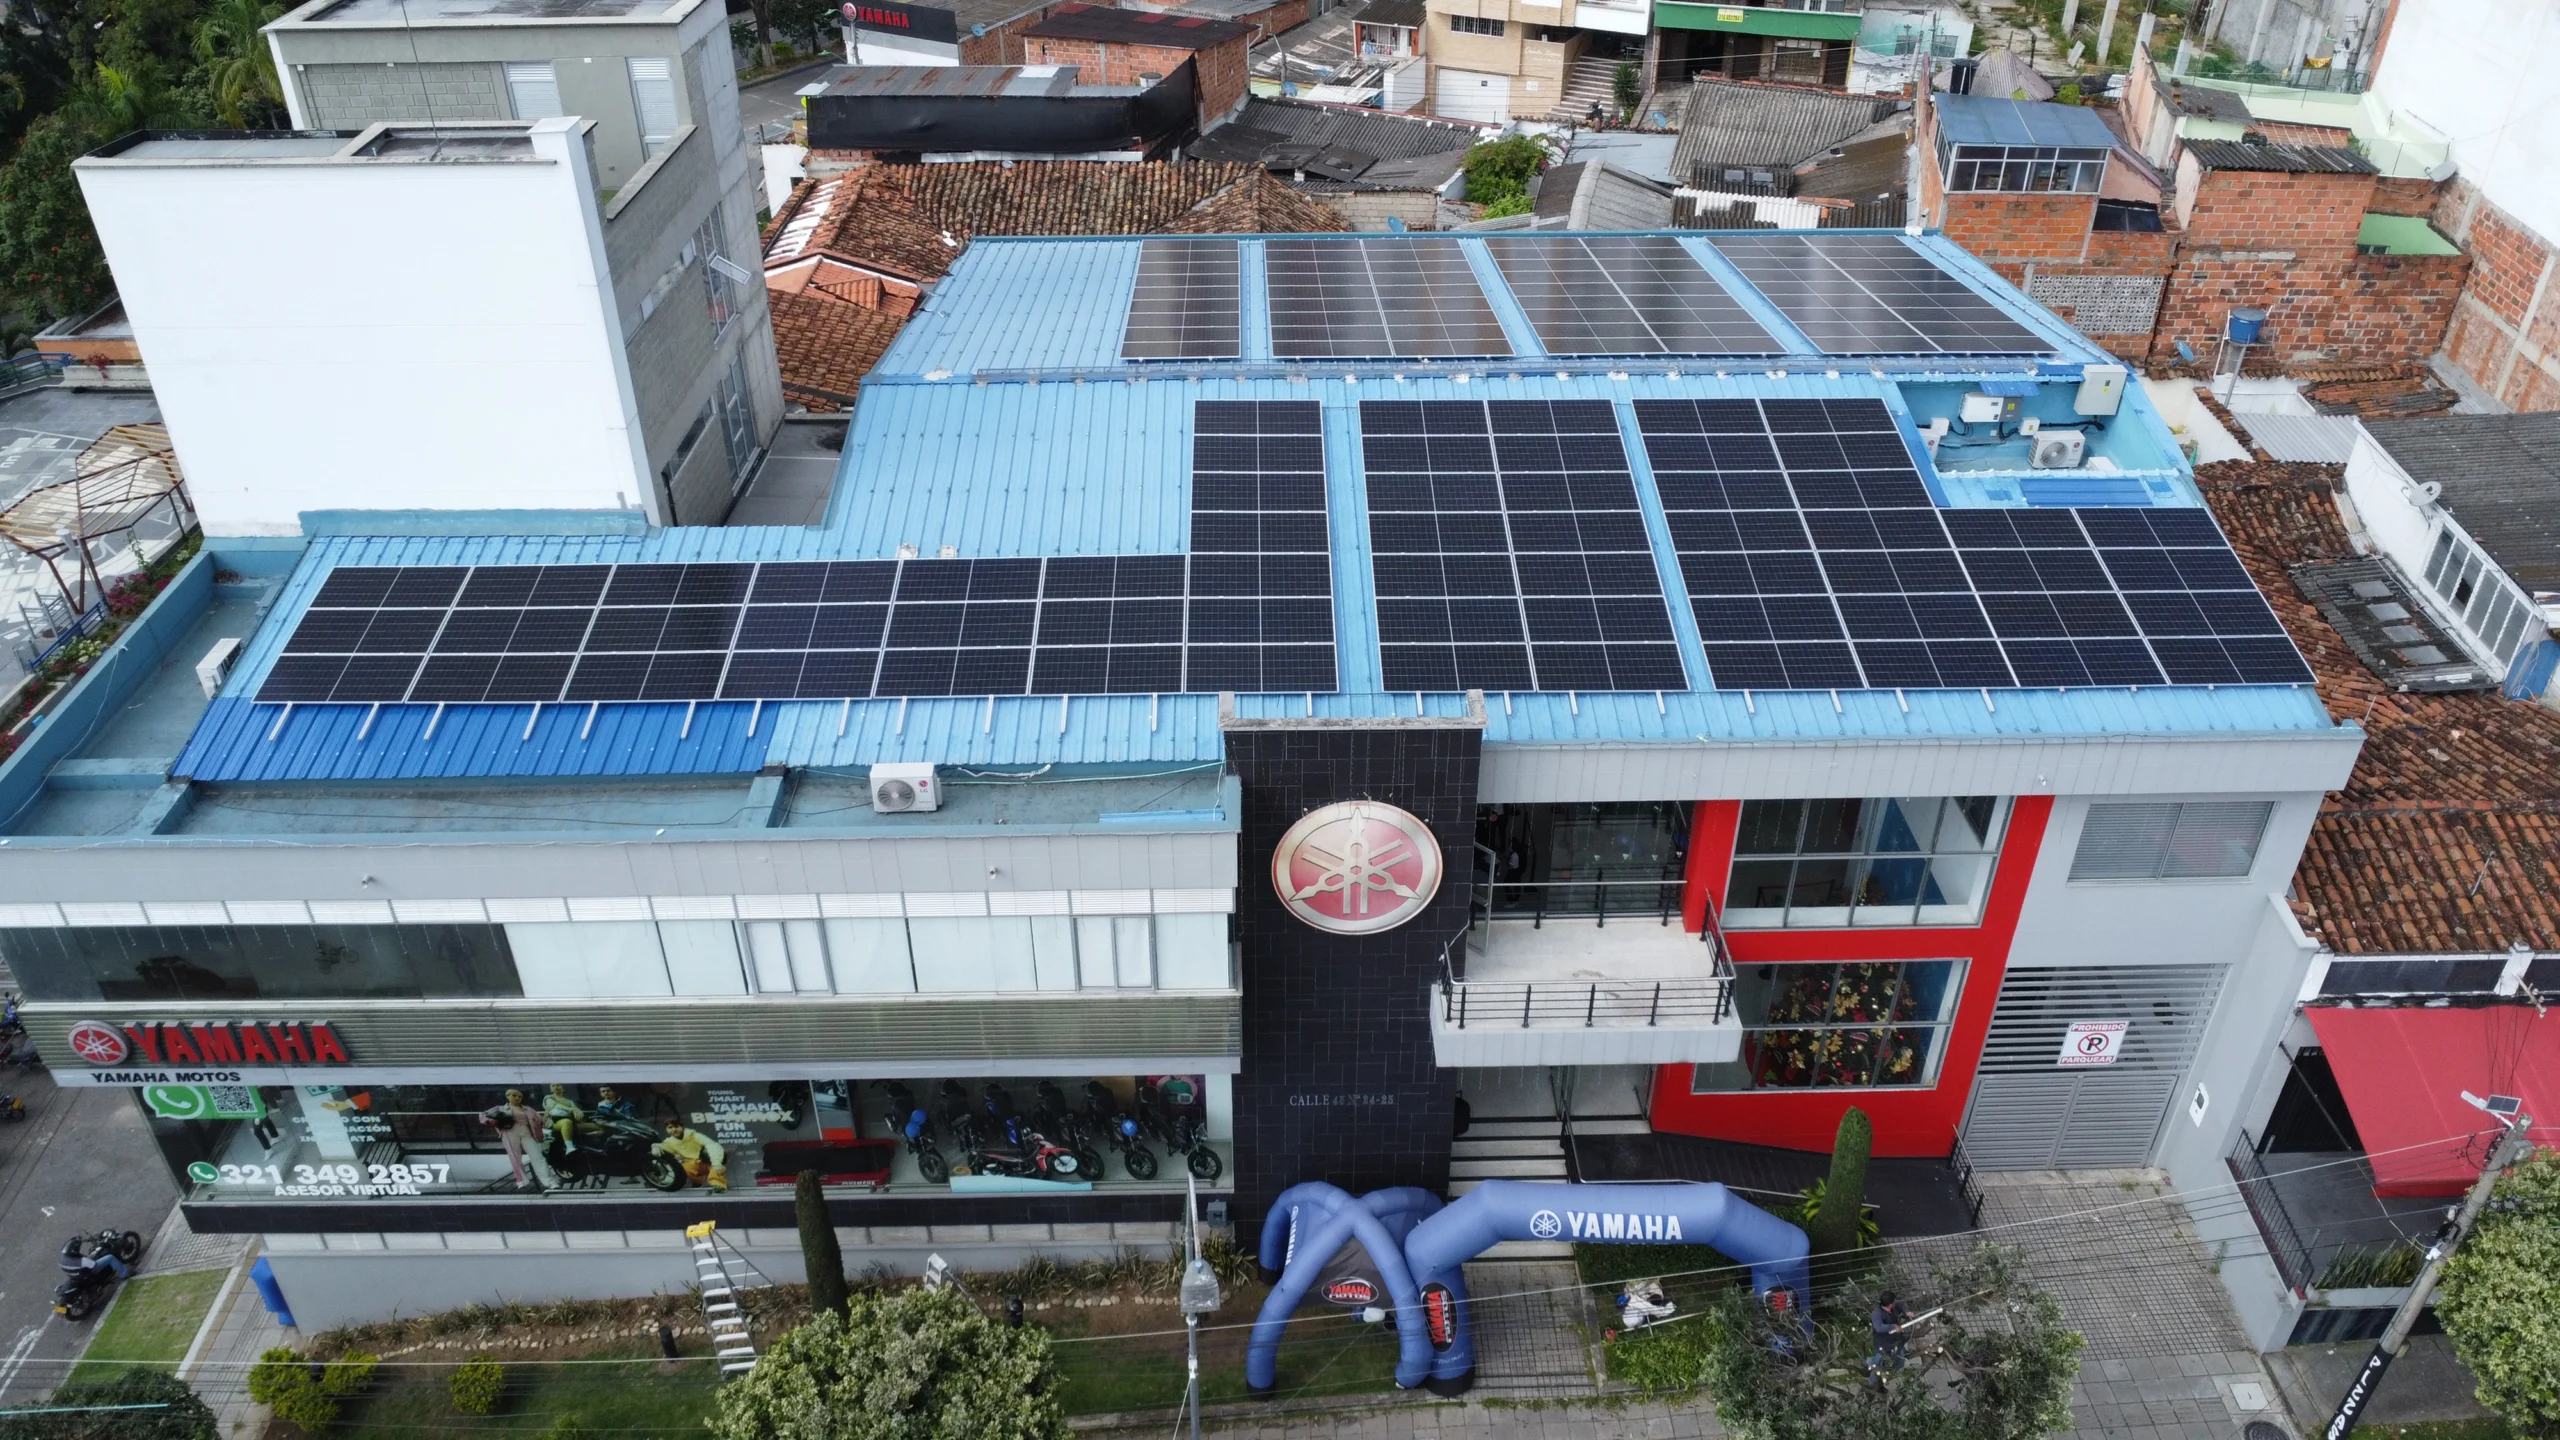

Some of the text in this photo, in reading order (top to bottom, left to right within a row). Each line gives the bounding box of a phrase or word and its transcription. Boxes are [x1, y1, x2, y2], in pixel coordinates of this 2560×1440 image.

[857, 6, 910, 28] YAMAHA
[124, 1021, 349, 1063] YAMAHA
[91, 1071, 241, 1083] YAMAHA MOTOS
[1289, 1095, 1330, 1106] CALLE
[710, 1103, 782, 1112] YAMAHA
[714, 1122, 746, 1131] FUN
[220, 1163, 450, 1185] 321 349 2857
[275, 1184, 421, 1196] ASESOR VIRTUAL
[1566, 1211, 1683, 1240] YAMAHA
[1328, 1285, 1372, 1297] YAMAHA
[1427, 1290, 1447, 1344] YAMAHA
